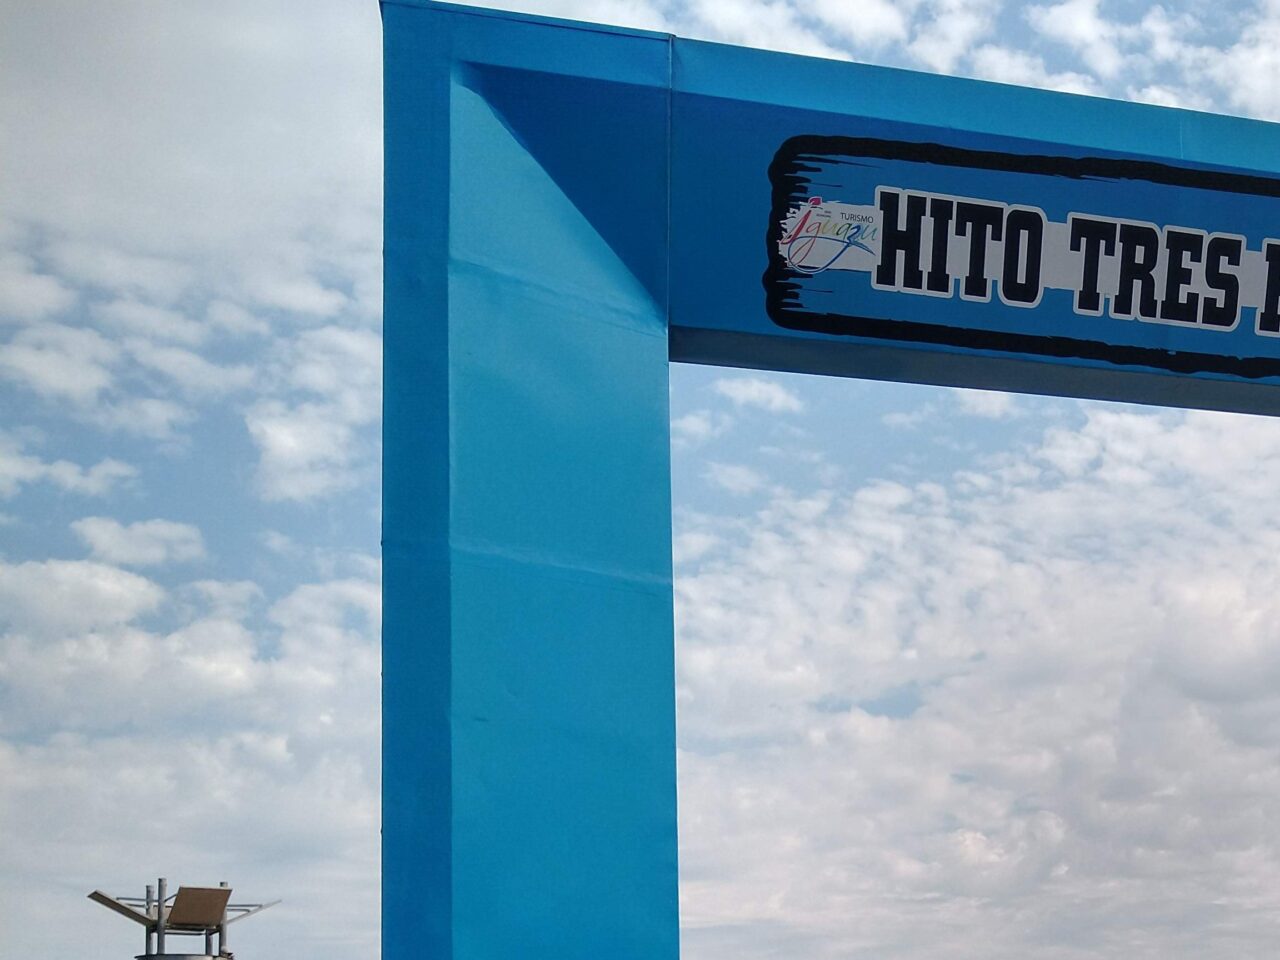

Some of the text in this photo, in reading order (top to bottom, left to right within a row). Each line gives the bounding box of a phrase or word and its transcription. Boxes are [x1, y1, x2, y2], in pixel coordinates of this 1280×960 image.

[840, 212, 874, 224] TURISMO
[875, 191, 1043, 303] HITO
[1070, 217, 1242, 326] TRES
